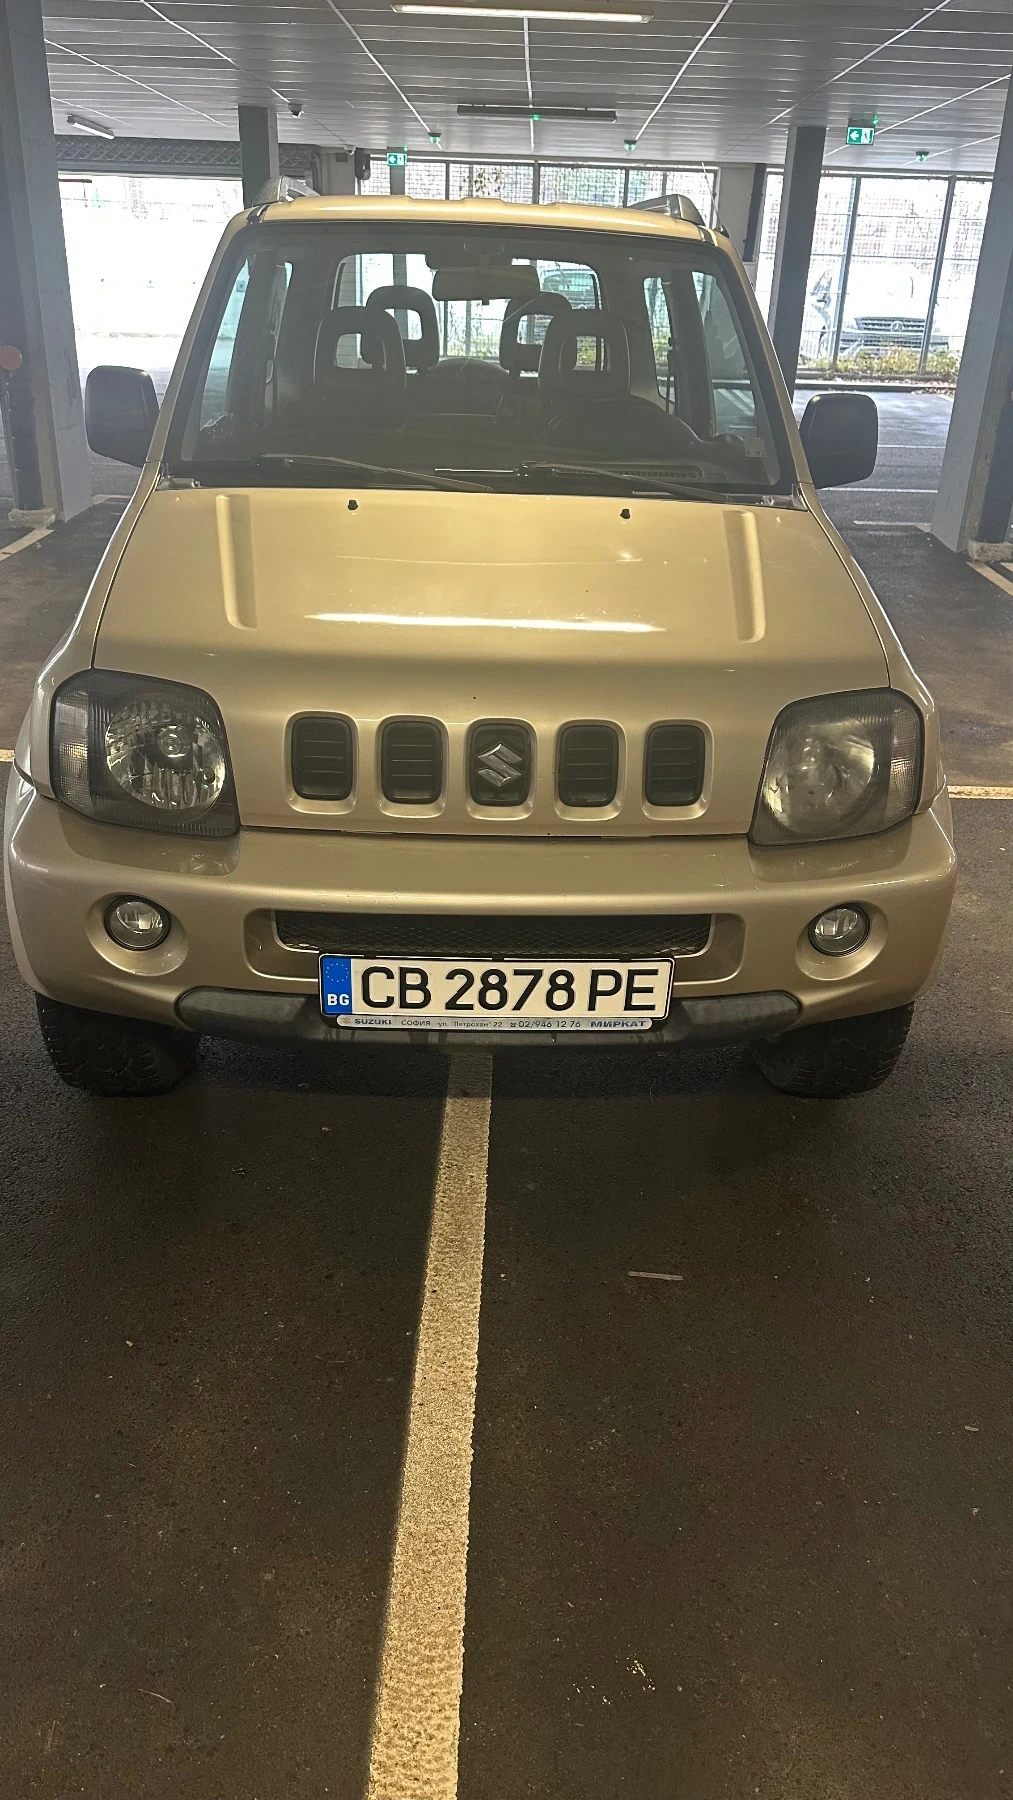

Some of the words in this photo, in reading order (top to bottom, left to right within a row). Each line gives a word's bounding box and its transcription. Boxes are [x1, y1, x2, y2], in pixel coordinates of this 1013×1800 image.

[361, 966, 431, 1010] CB
[445, 968, 575, 1012] 2878
[588, 969, 657, 1011] PE
[327, 994, 350, 1006] BG
[354, 1018, 392, 1026] SUZUKI
[556, 1020, 567, 1028] 12
[569, 1020, 581, 1028] 76
[590, 1020, 647, 1028] МИРКАТ
